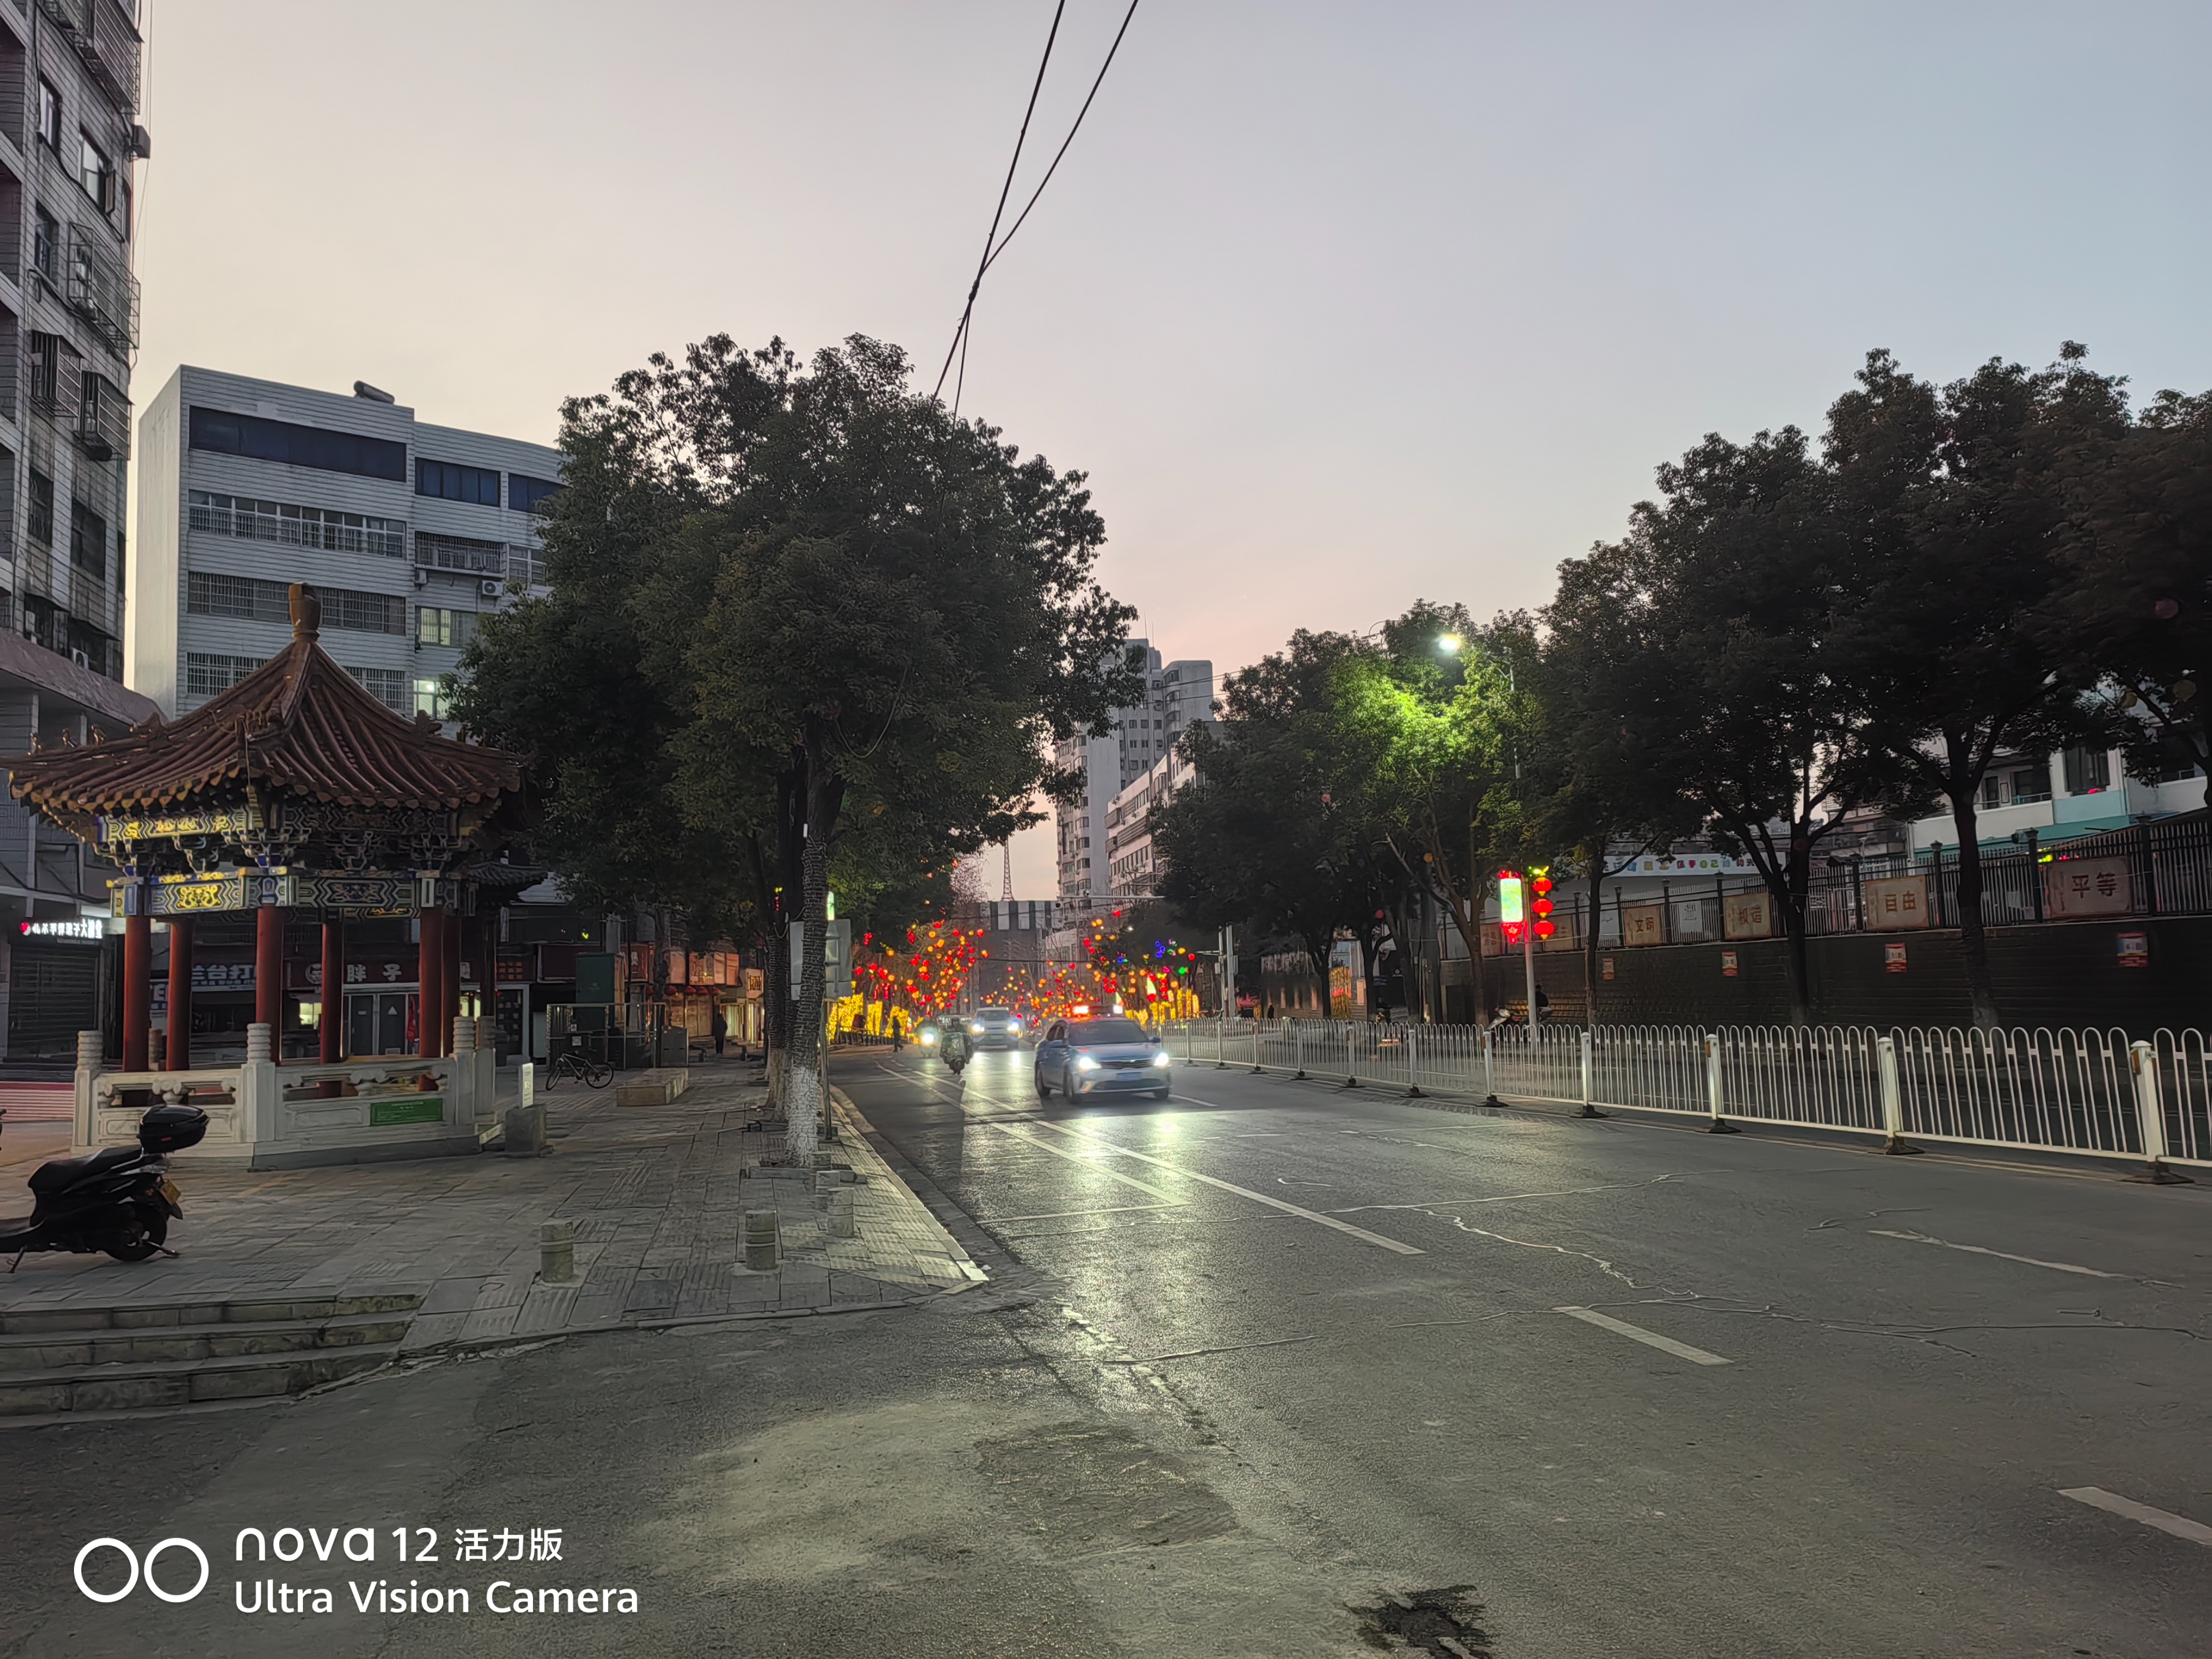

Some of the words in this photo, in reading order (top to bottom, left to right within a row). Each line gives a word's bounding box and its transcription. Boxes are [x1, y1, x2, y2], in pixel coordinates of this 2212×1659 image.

[2072, 871, 2116, 899] 平等
[1885, 889, 1916, 914] 自由
[1635, 916, 1655, 932] 文明
